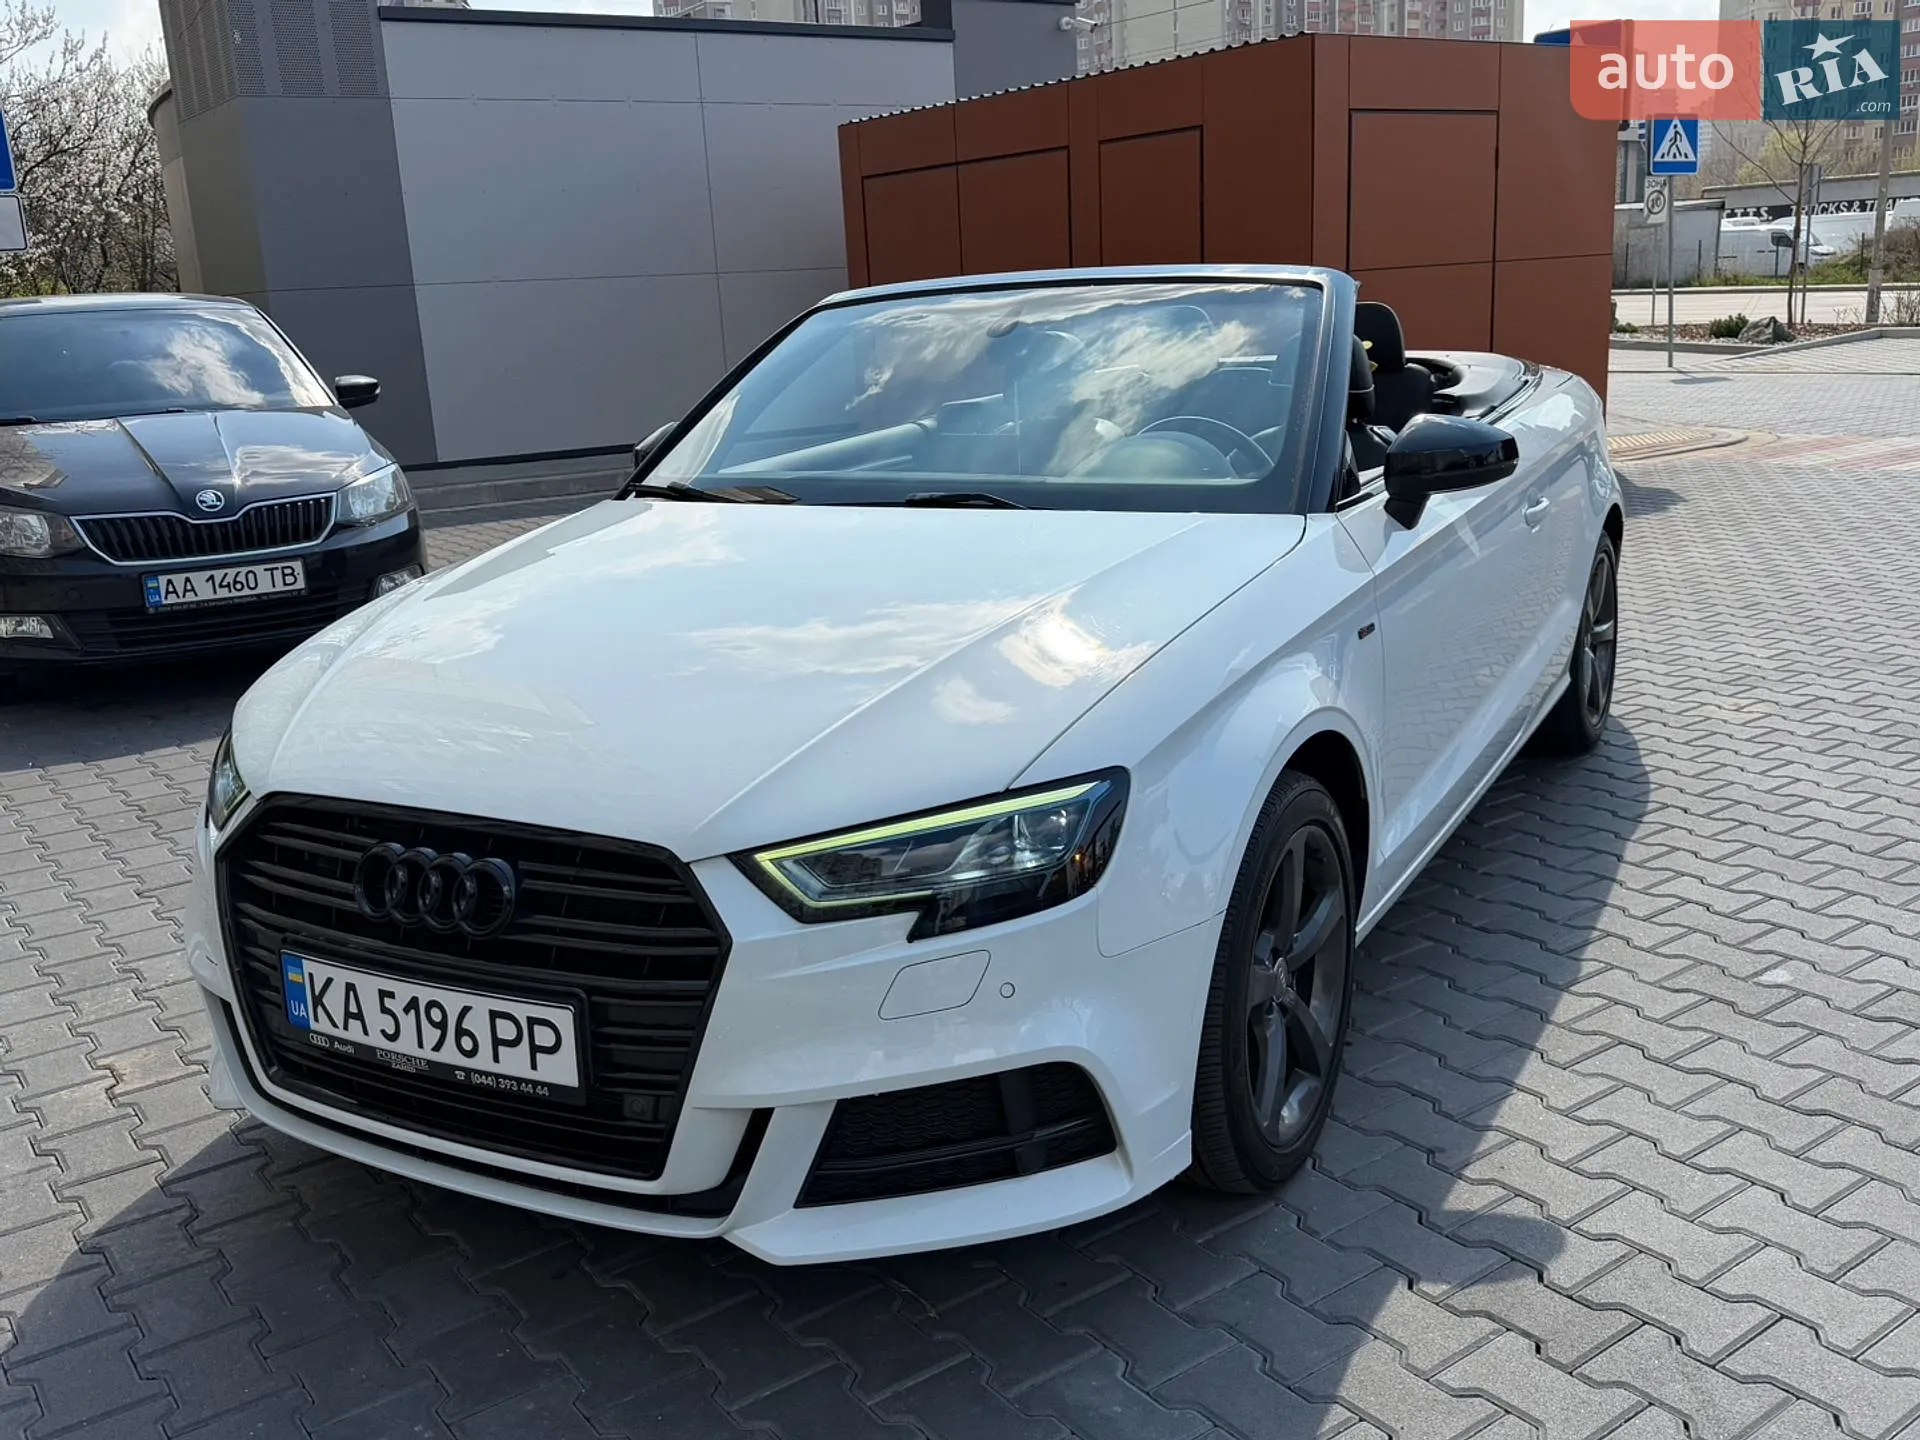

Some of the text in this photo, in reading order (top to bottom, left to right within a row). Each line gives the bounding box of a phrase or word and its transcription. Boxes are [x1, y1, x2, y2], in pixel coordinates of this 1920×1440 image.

[164, 576, 199, 600] AA
[205, 569, 259, 595] 1460
[263, 565, 298, 588] TB
[290, 1000, 308, 1019] UA
[308, 971, 562, 1071] KA 5196 PP
[334, 1041, 355, 1056] Audi
[376, 1048, 429, 1069] PORSCHE
[470, 1071, 549, 1096] (044) 393 44 44
